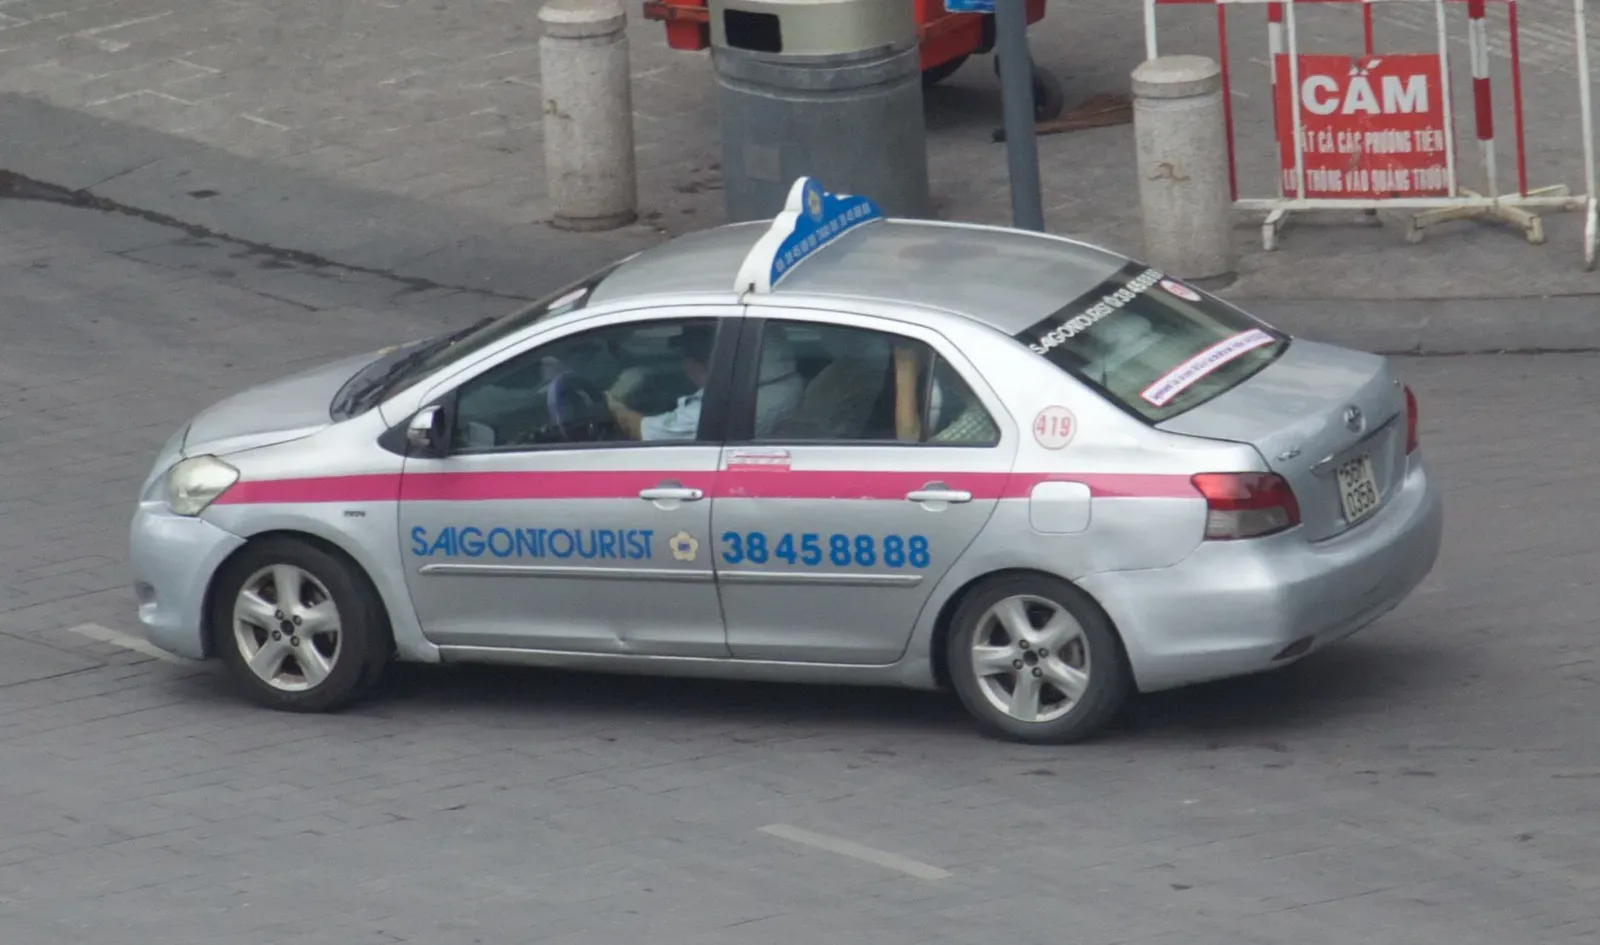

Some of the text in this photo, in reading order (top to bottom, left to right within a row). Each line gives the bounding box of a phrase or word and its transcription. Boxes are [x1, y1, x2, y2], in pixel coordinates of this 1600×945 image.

[1301, 58, 1429, 115] CẤM
[1294, 125, 1315, 153] ẤT
[1036, 414, 1071, 438] 419
[411, 526, 655, 560] SAIGONTOURIST
